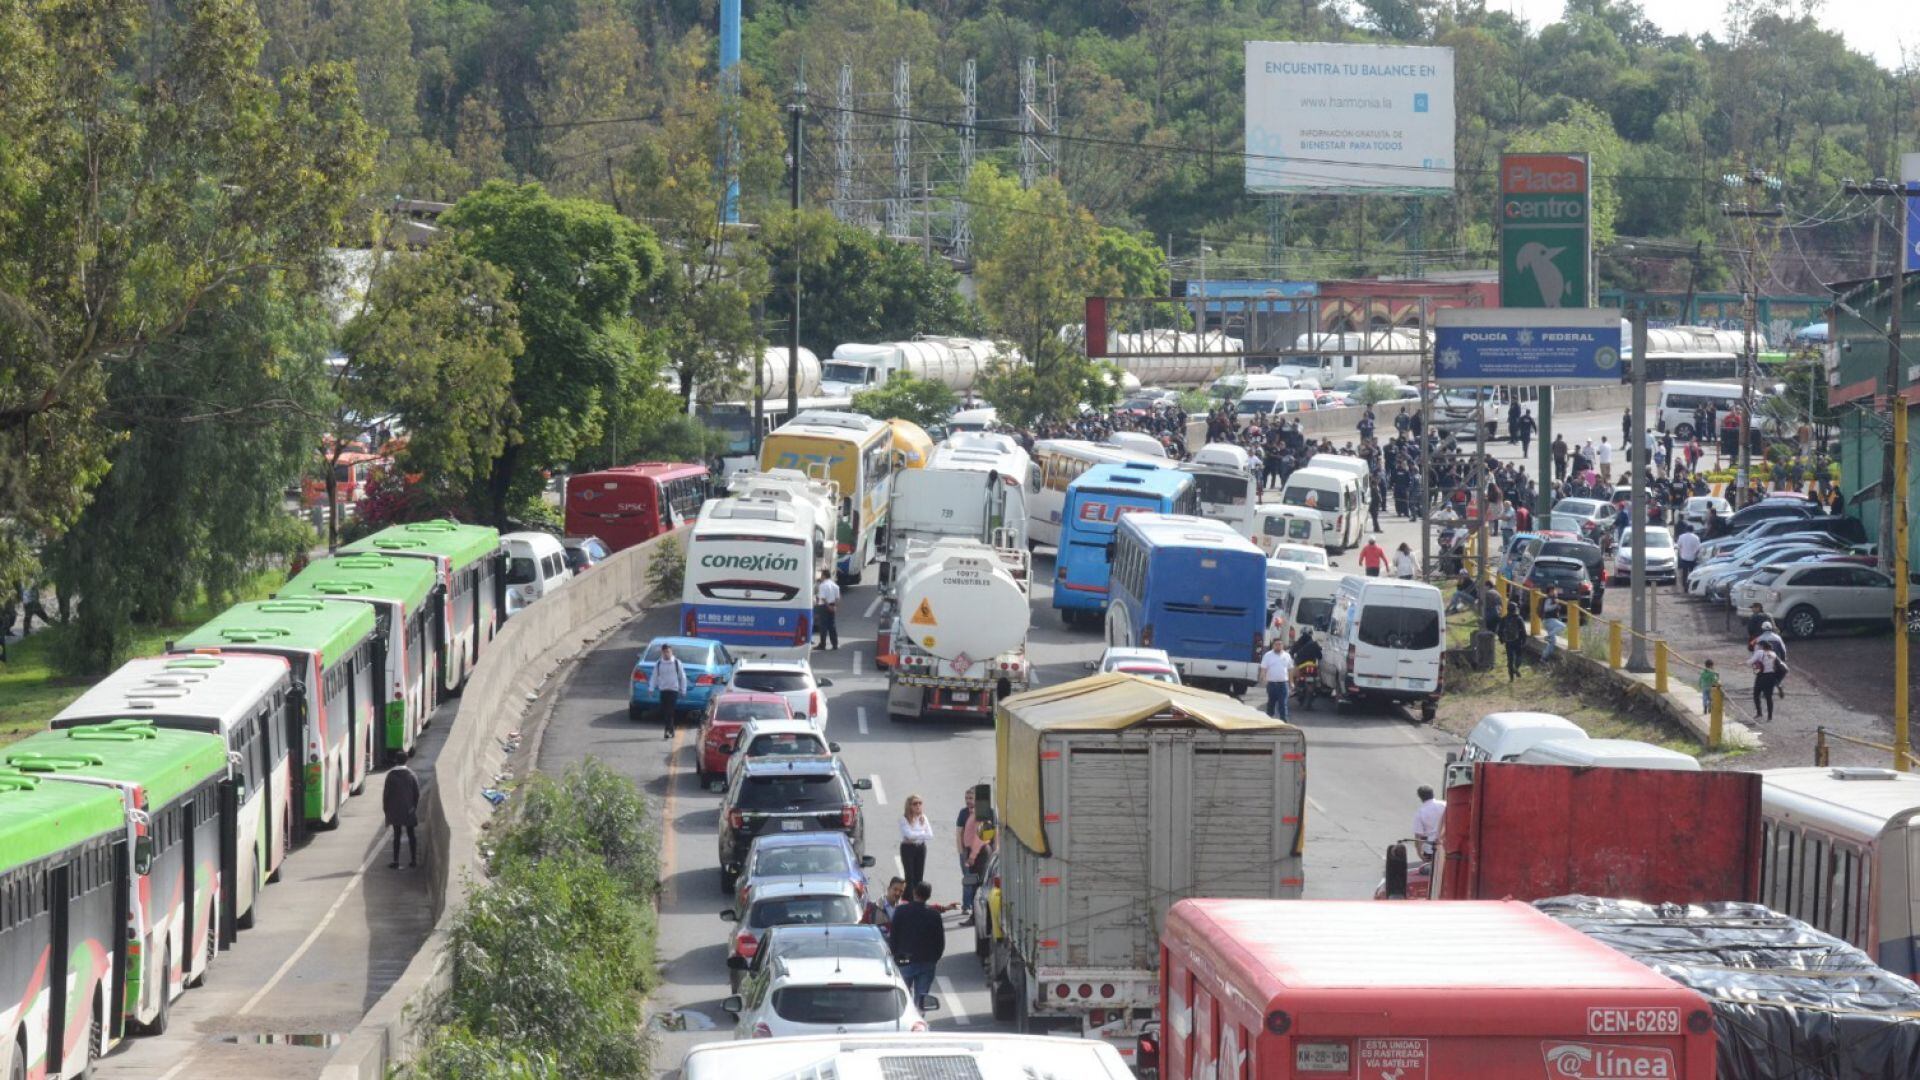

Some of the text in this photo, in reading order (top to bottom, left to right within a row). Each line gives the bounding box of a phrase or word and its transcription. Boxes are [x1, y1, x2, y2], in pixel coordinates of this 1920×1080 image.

[1265, 61, 1435, 77] ENCUENTRA TU BALANCE EN
[1393, 130, 1402, 138] DE
[1300, 140, 1402, 150] BIENESTAR PARA TODOS
[1509, 166, 1577, 190] Placa
[1462, 332, 1595, 341] POLICÍA FEDERAL
[700, 552, 799, 571] conexión
[942, 577, 990, 586] COMBUSTIBLES
[1590, 1009, 1678, 1032] CEN-6269
[1366, 1041, 1421, 1050] ESTA UNIDAD
[1361, 1049, 1424, 1058] ES RASTREADA
